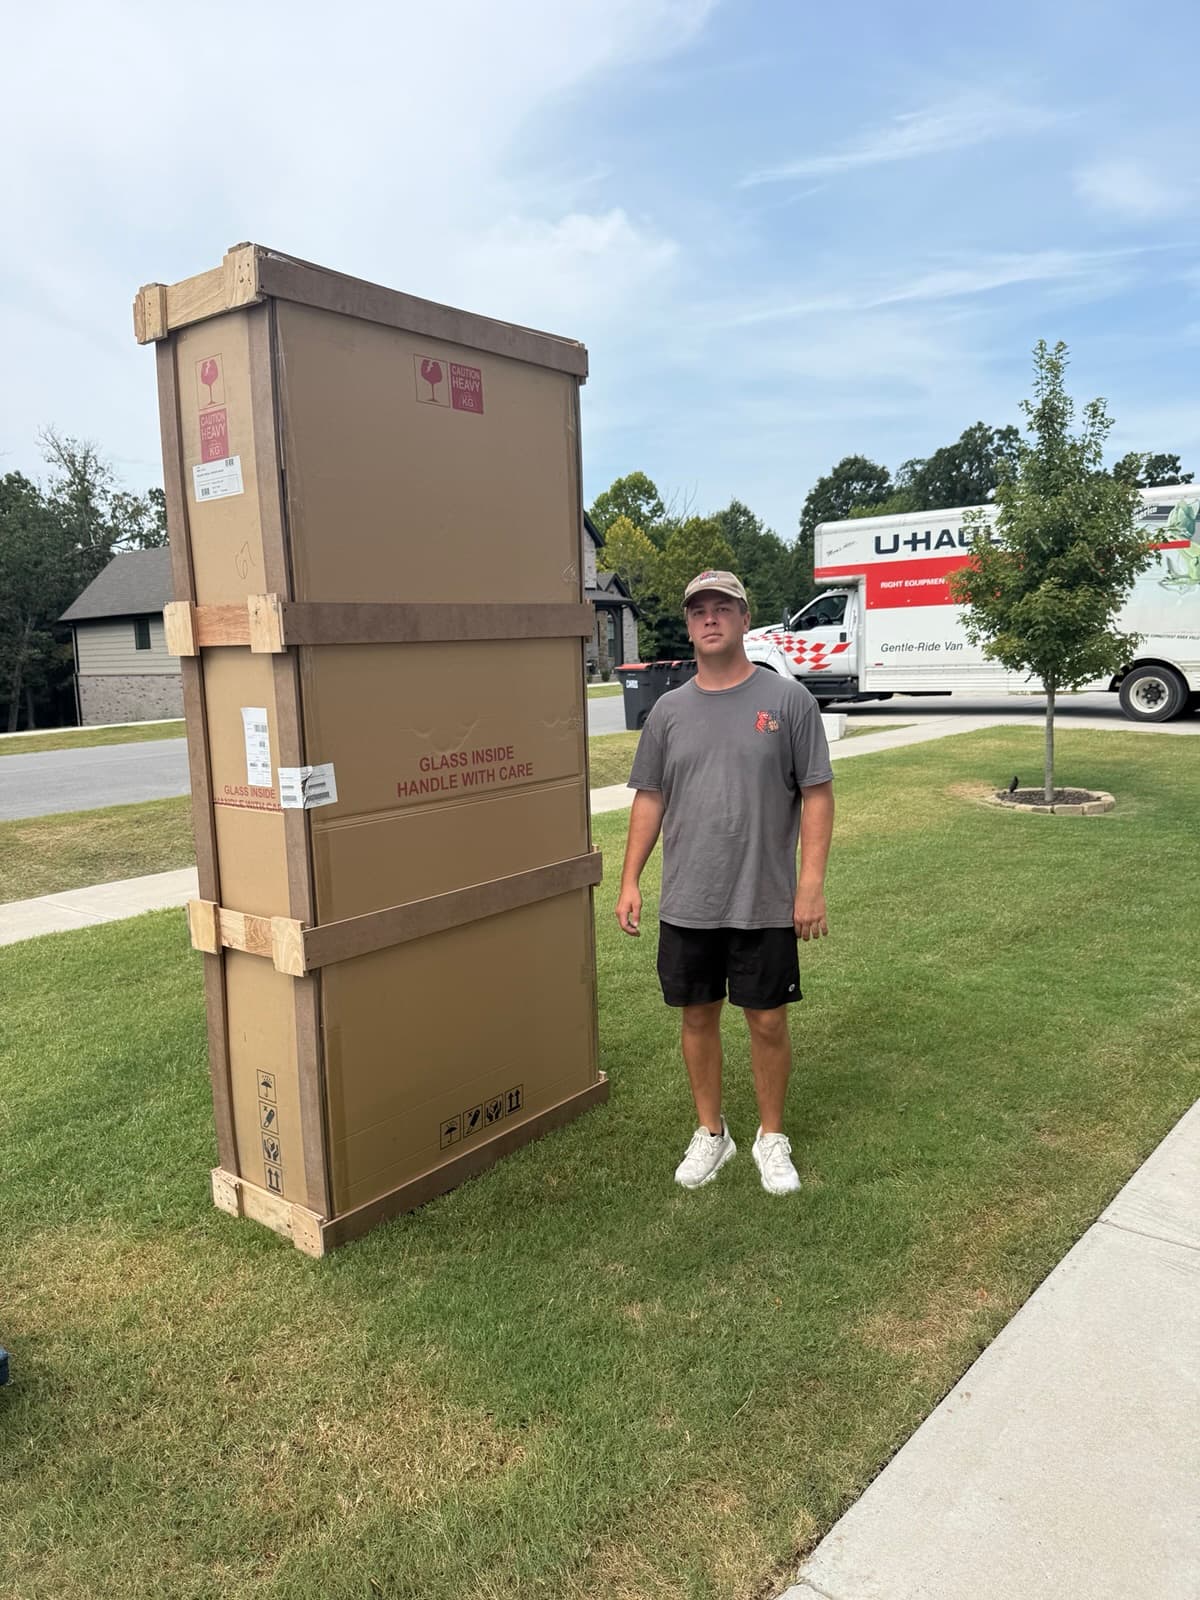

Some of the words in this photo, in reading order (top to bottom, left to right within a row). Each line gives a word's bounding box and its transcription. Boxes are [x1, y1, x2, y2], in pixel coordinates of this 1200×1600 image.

[452, 366, 480, 380] CAUTION
[452, 376, 480, 392] HEAVY
[463, 398, 474, 408] KG
[200, 412, 226, 426] CAUTION
[201, 423, 226, 441] HEAVY
[875, 525, 1003, 555] U-HAUL
[880, 581, 902, 589] RIGHT
[904, 578, 949, 588] EQUIPMEN
[881, 642, 941, 653] Gentle-Ride
[944, 641, 963, 651] Van
[420, 752, 468, 772] GLASS
[471, 745, 515, 765] INSIDE
[397, 774, 458, 798] HANDLE
[461, 768, 496, 787] WITH
[499, 762, 534, 781] CARE
[224, 785, 249, 798] GLASS
[250, 786, 276, 800] INSIDE
